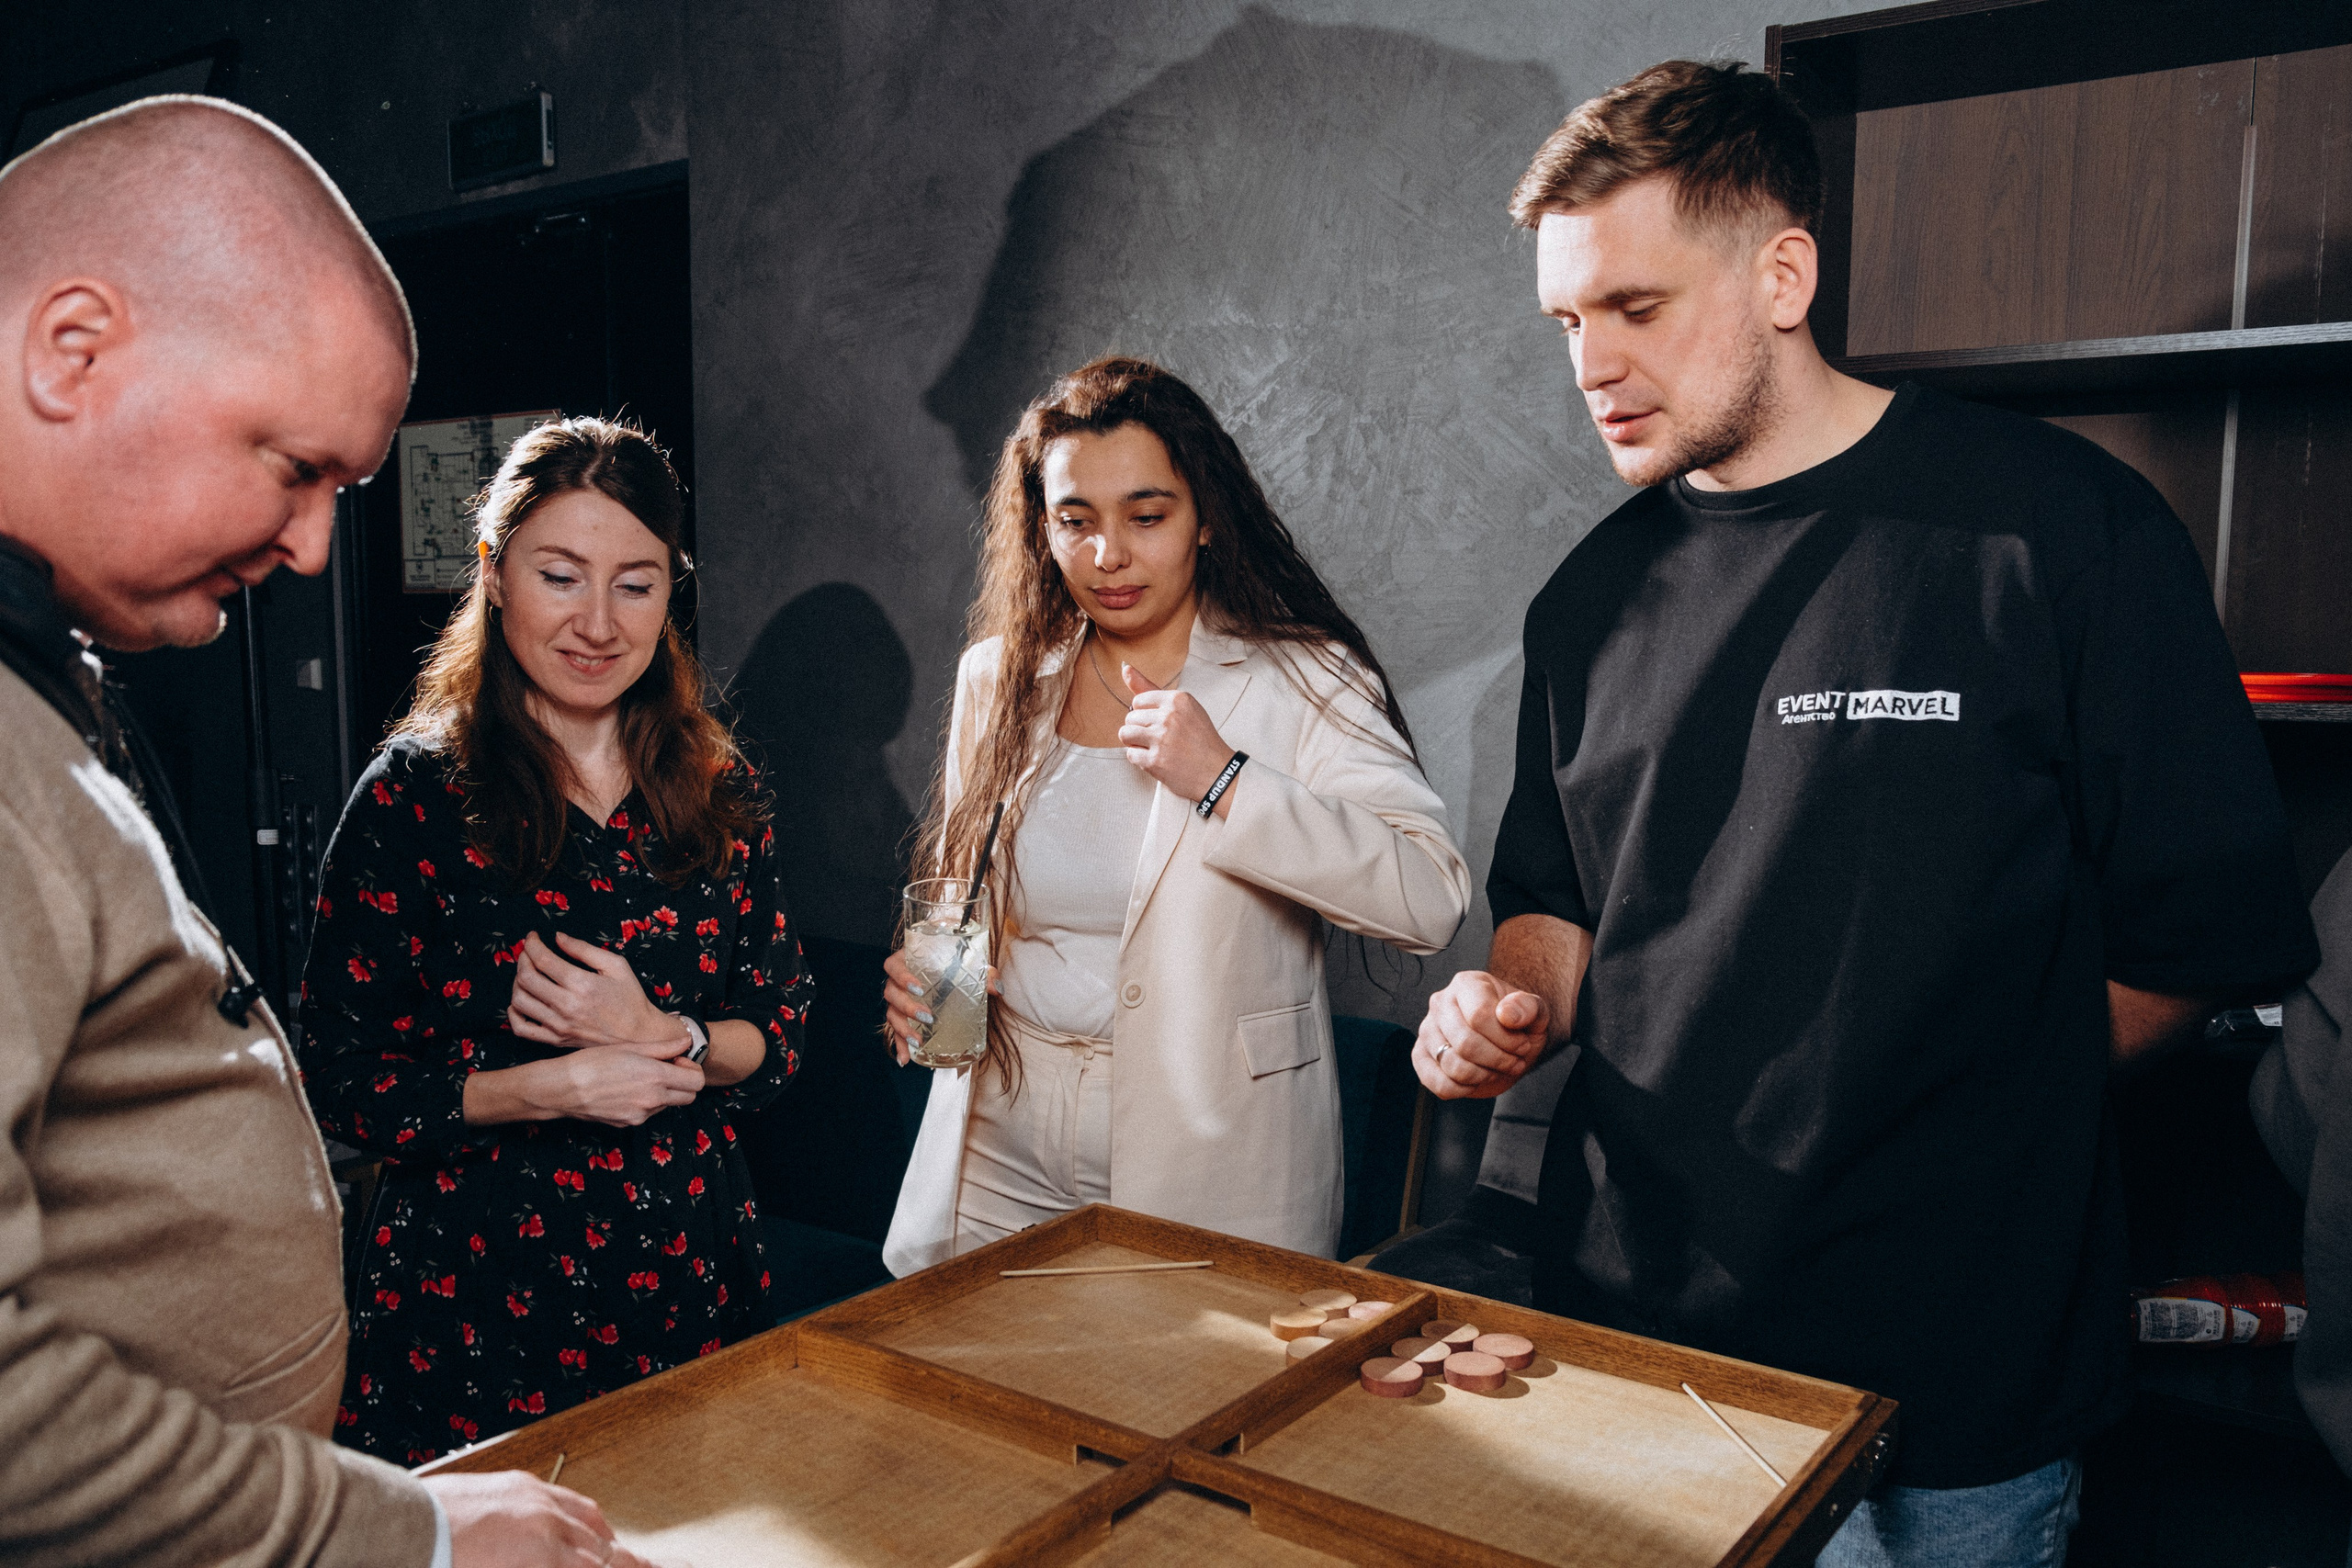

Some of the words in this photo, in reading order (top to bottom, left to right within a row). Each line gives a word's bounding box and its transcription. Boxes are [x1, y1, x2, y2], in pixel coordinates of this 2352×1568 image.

[1778, 691, 1846, 716] EVENT
[1851, 694, 1955, 717] MARVEL
[1209, 759, 1240, 802] STANDUP
[1198, 800, 1211, 818] SPO
